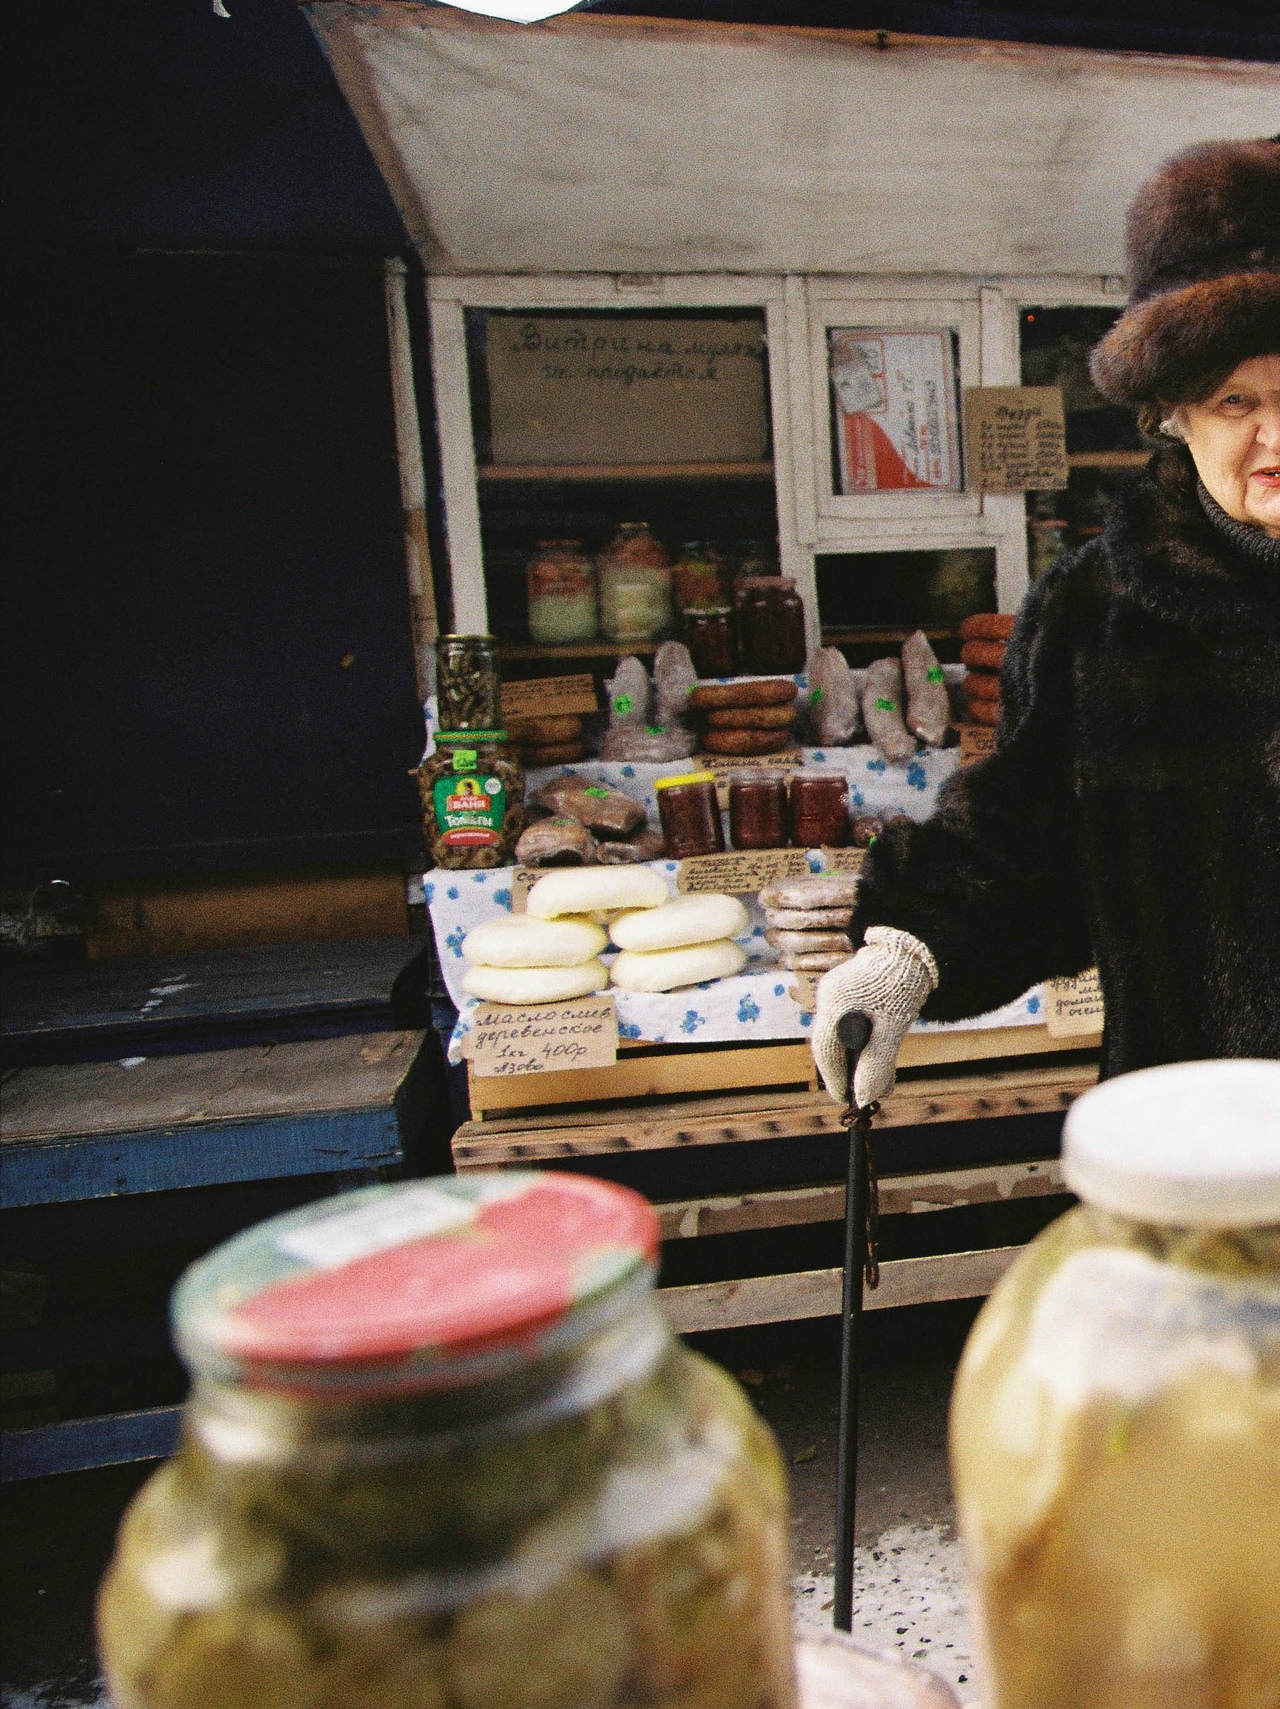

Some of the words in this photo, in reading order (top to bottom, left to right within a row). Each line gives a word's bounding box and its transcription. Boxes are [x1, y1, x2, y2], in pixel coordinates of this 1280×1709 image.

[511, 322, 676, 361] Витрина
[475, 1010, 556, 1026] Масло
[561, 1006, 612, 1020] слив
[475, 1022, 604, 1049] деревенское
